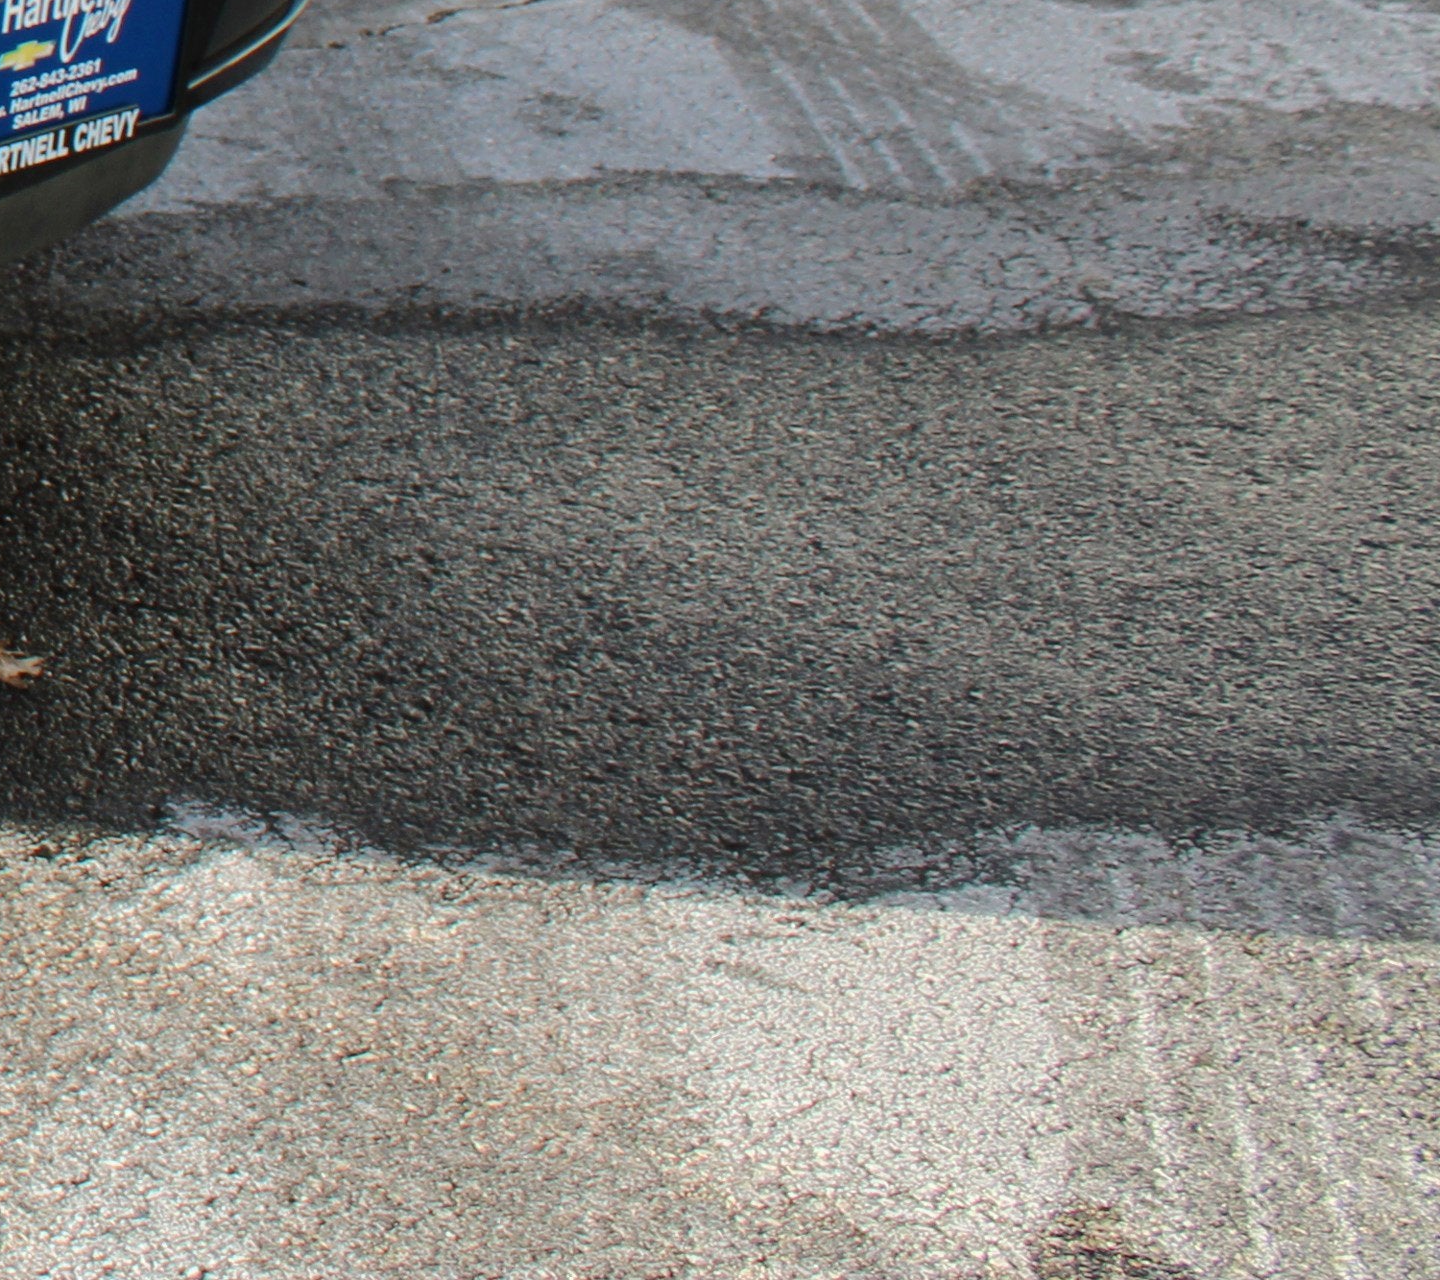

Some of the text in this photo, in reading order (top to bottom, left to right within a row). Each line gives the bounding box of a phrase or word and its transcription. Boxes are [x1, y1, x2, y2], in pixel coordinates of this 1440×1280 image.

[9, 57, 102, 98] 262-843-2361
[9, 68, 139, 115] HartnellChevy.com
[11, 95, 88, 130] SALEM, WI
[72, 107, 141, 153] CHEVY
